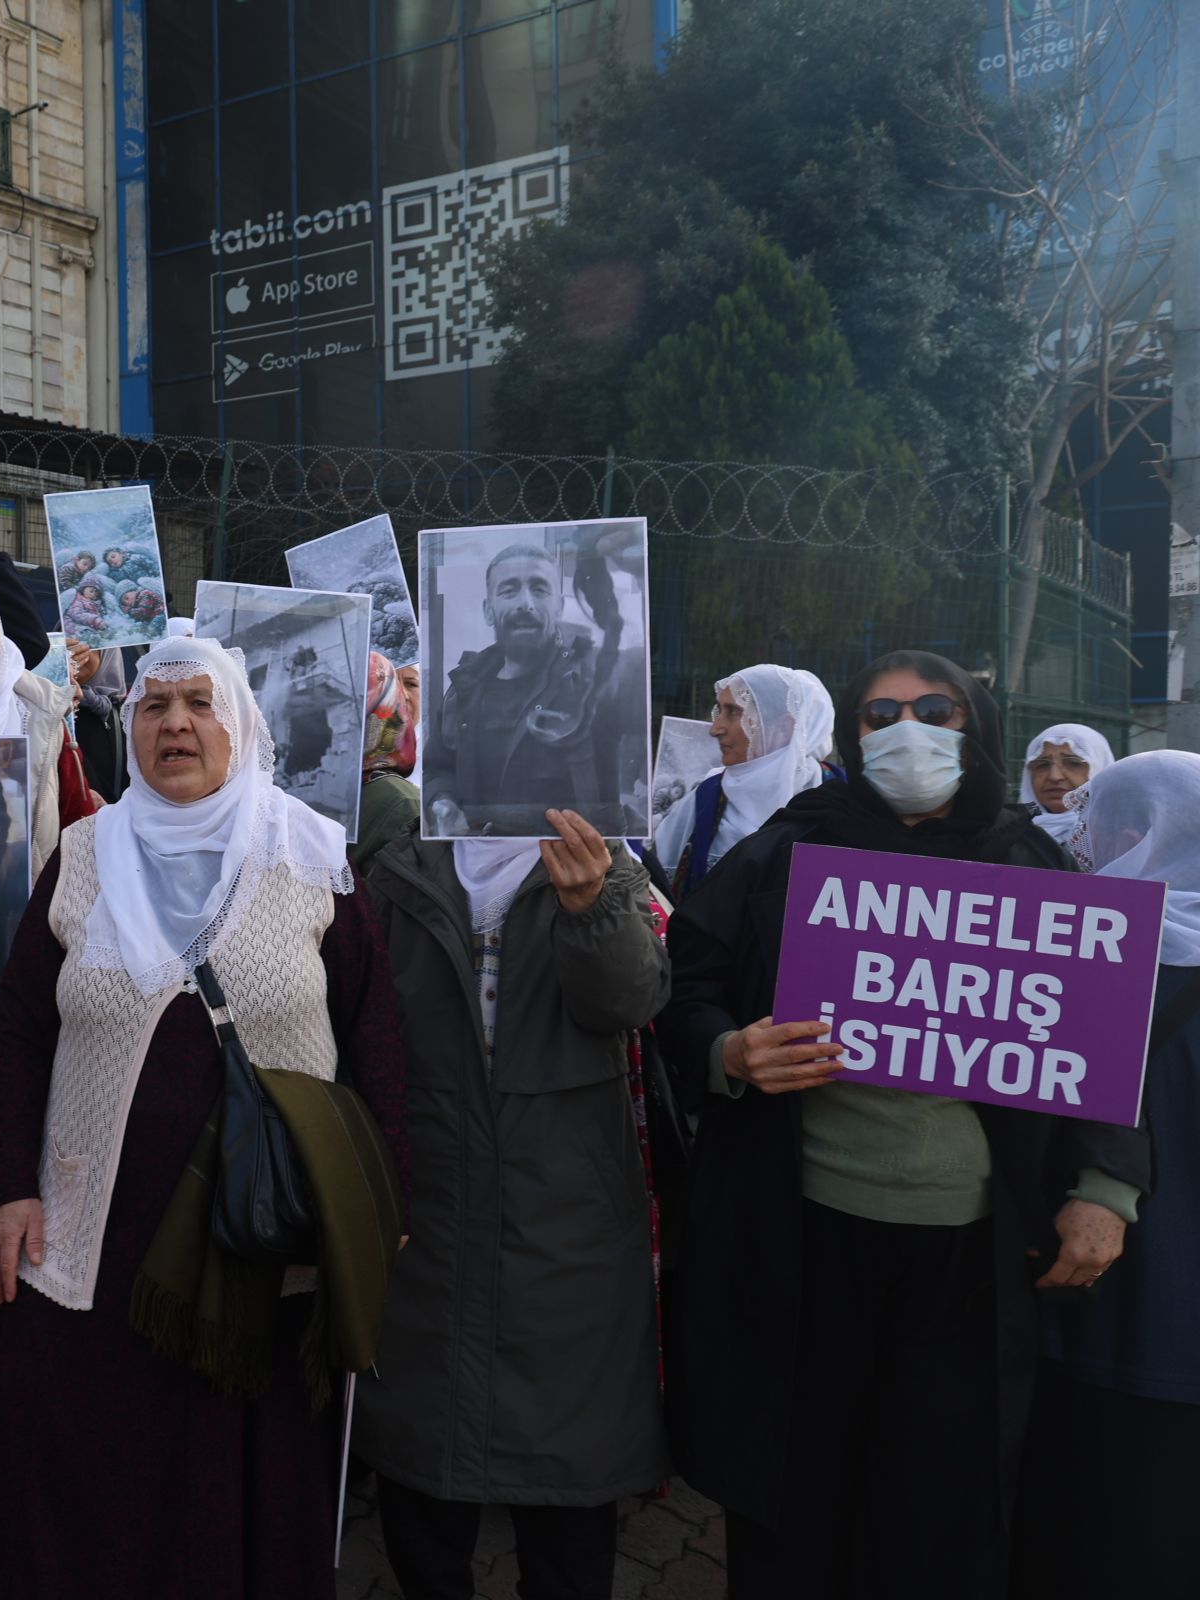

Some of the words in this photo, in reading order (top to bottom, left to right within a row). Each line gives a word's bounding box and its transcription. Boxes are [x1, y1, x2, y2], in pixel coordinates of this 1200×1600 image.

[1021, 24, 1062, 42] UEFA
[1010, 53, 1075, 78] EAGU
[209, 199, 372, 256] tabii.com
[261, 279, 300, 305] App
[303, 268, 359, 296] Store
[807, 876, 1129, 963] ANNELER
[852, 950, 1064, 1043] BARIŞ
[814, 1002, 1087, 1106] İSTİYOR
